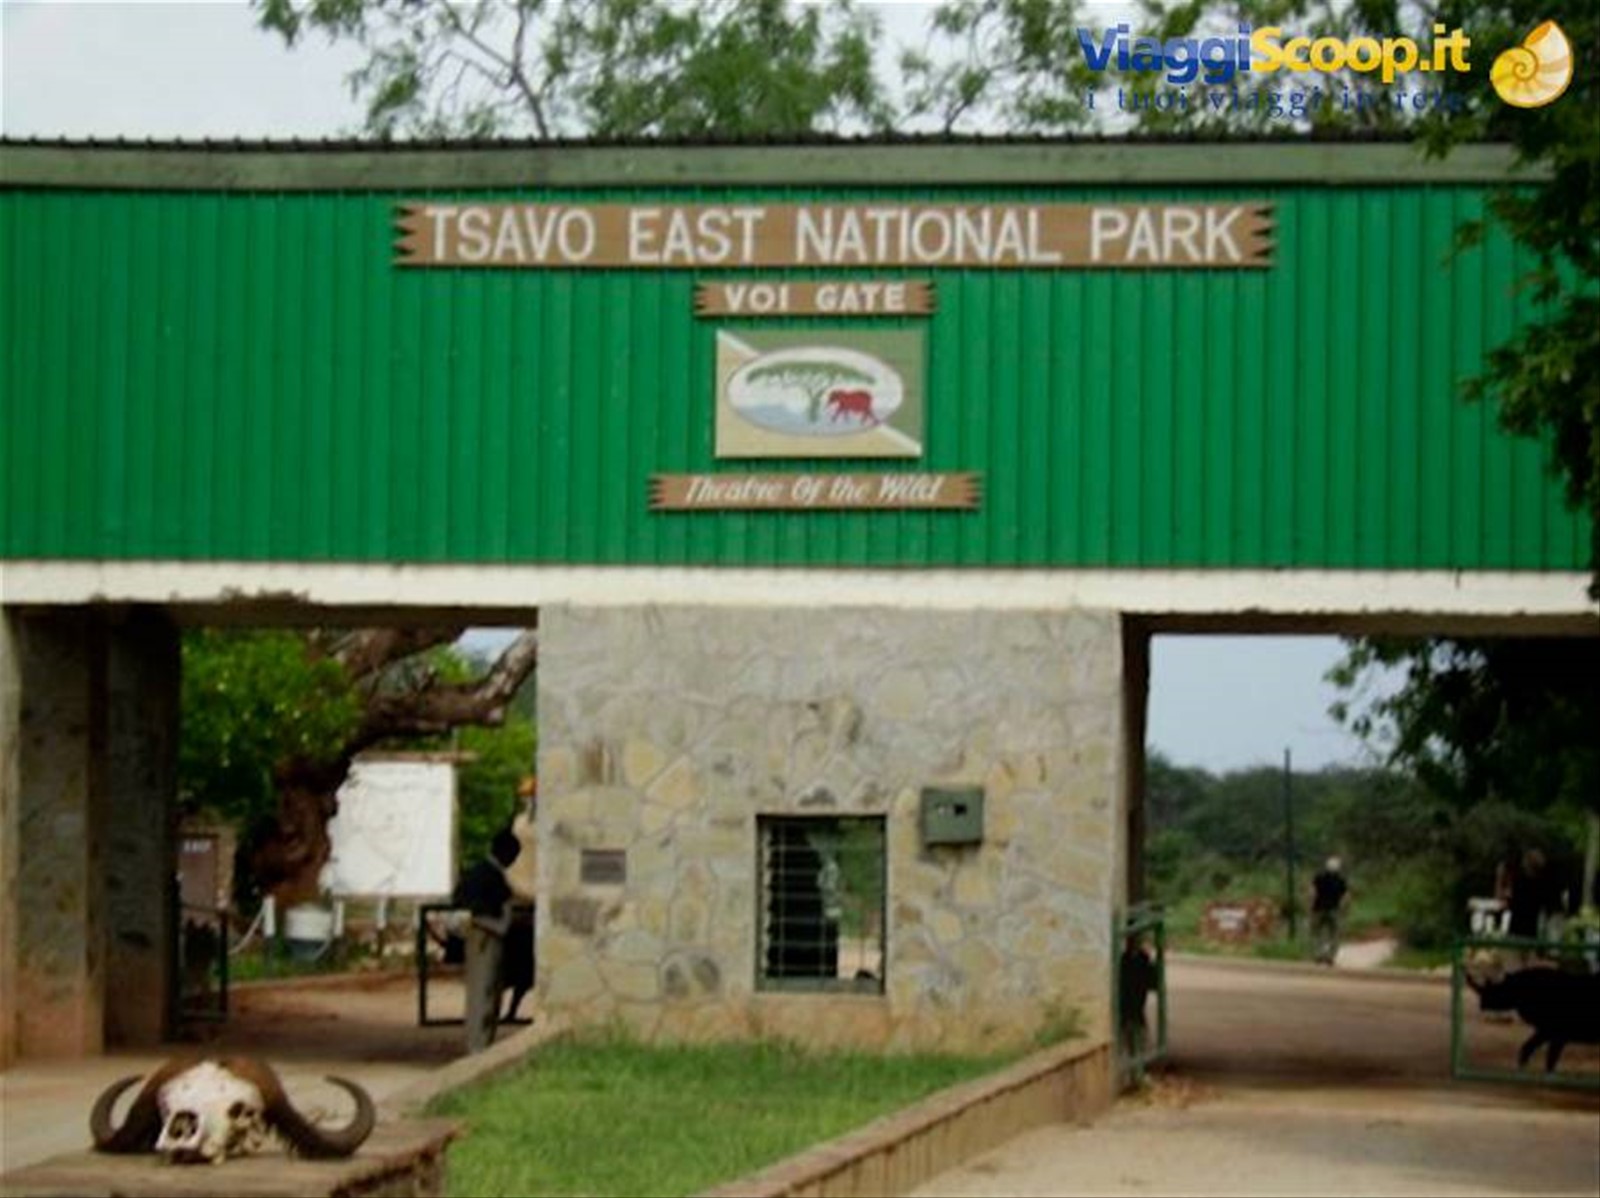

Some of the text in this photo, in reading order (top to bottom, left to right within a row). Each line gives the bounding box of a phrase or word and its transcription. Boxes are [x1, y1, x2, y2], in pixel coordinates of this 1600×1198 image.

[426, 207, 1243, 263] TSAVO EAST NATIONAL PARK
[724, 283, 906, 312] VOI GATE
[828, 475, 871, 501] the
